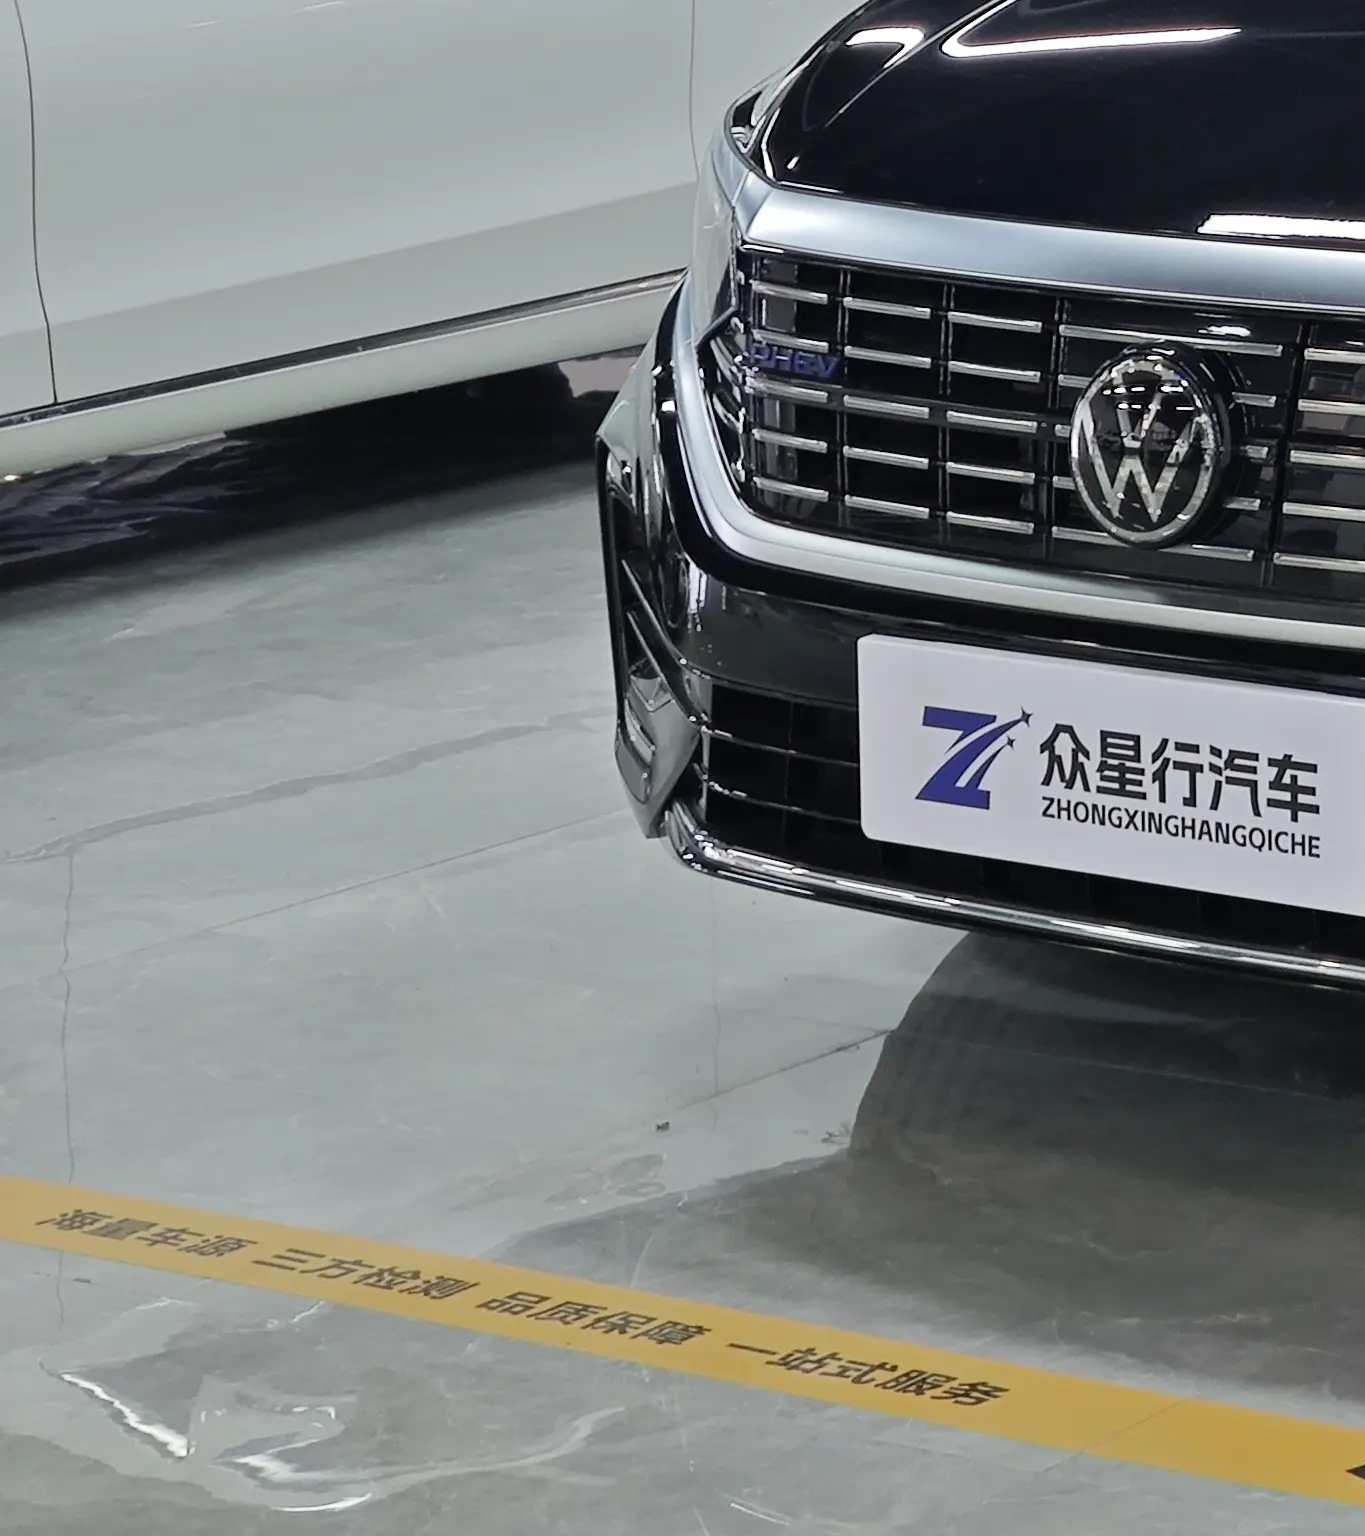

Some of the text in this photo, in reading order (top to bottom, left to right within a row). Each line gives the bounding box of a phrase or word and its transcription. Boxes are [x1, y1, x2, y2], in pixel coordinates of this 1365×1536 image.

[1040, 723, 1321, 823] 众星行汽车
[1041, 796, 1321, 859] ZHONGXINGHANGQICHE
[35, 1209, 1011, 1406] 海量车源 三方检测 品质保障 一站式服务
